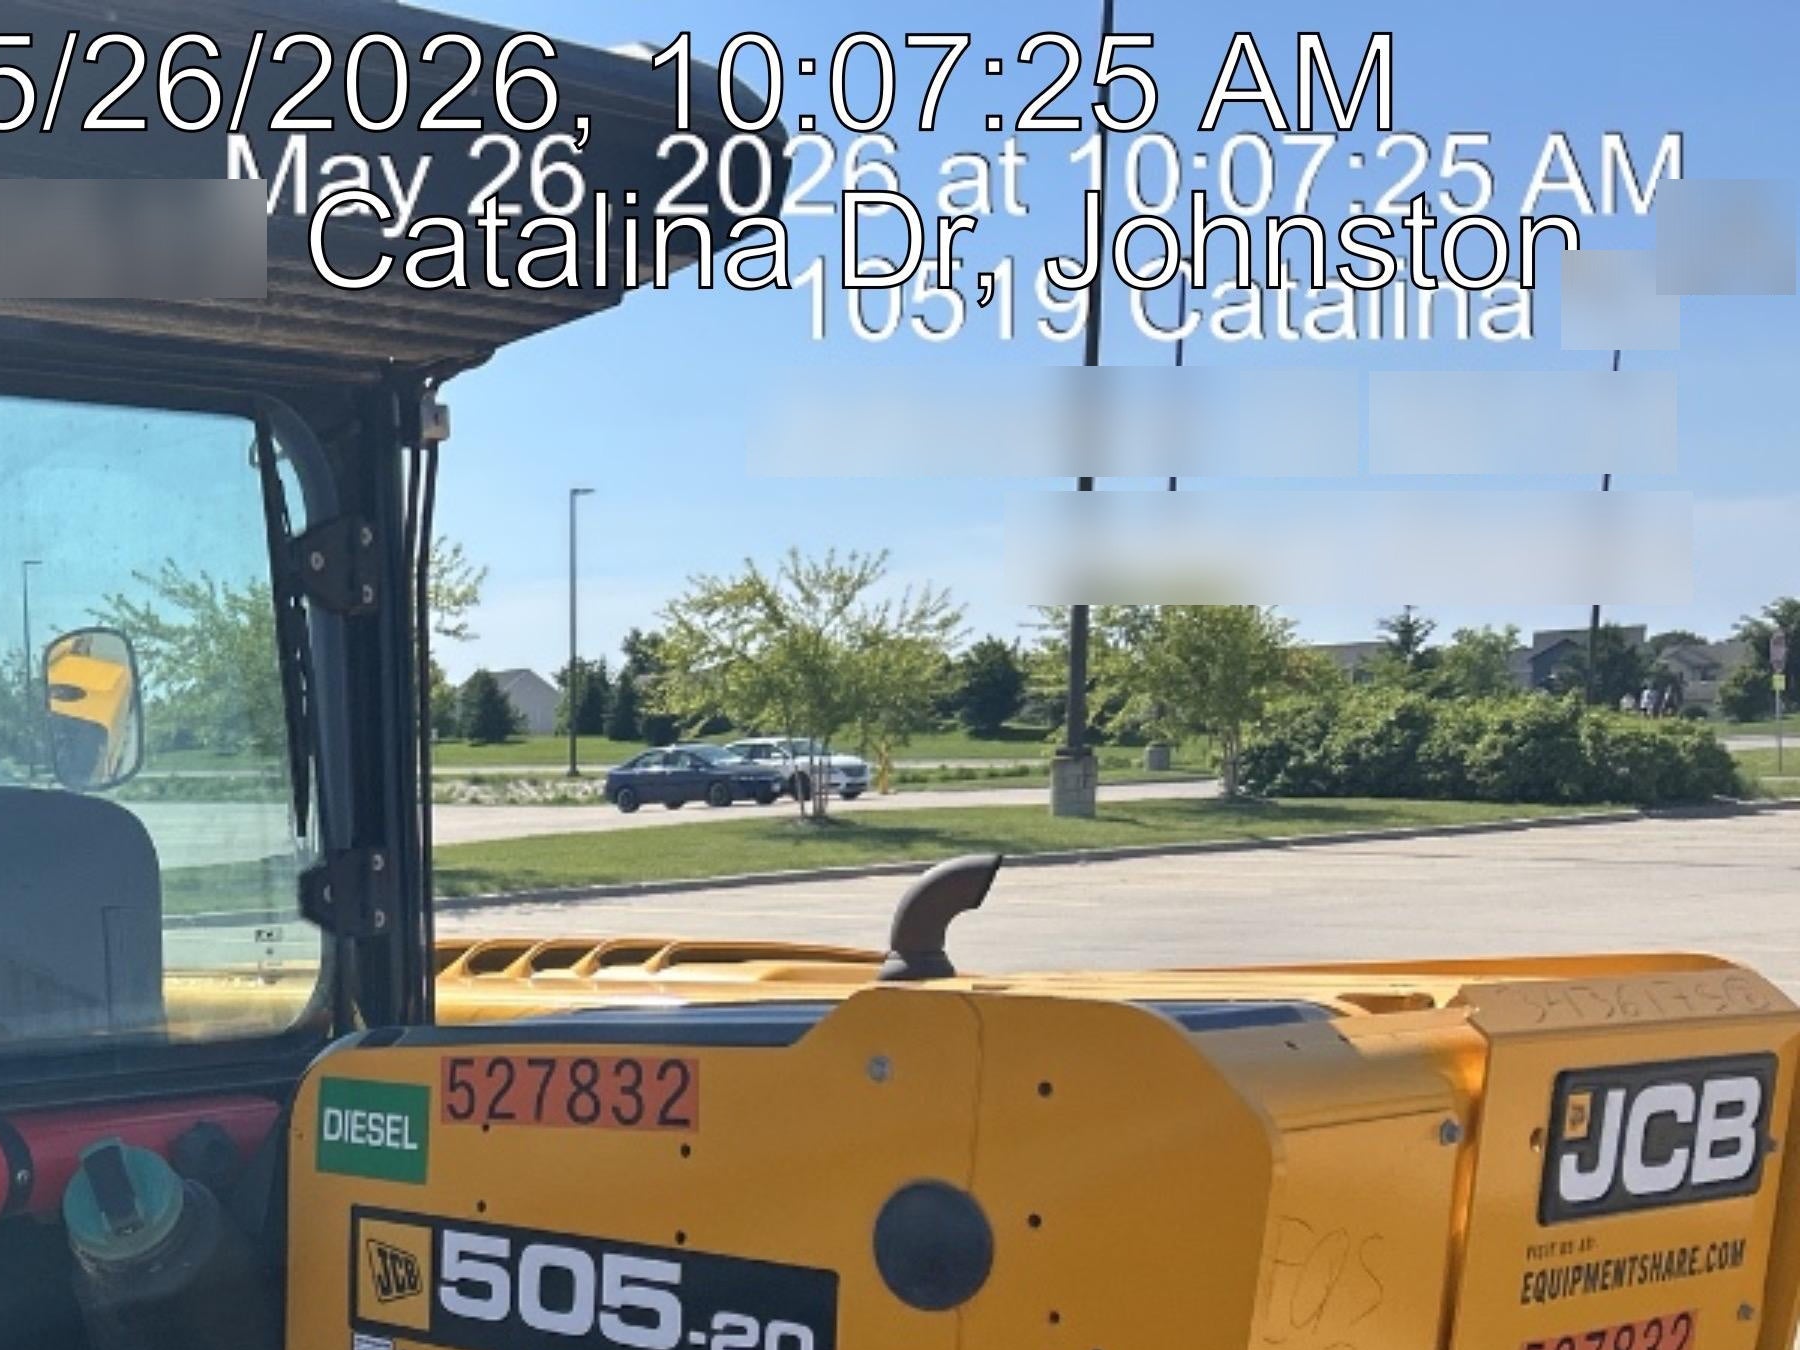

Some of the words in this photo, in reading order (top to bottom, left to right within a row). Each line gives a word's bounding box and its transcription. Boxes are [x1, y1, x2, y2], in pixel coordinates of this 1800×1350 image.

[445, 1056, 692, 1128] 527832
[322, 1106, 419, 1151] DIESEL
[1559, 1075, 1763, 1202] JCB
[375, 1246, 418, 1297] JCB
[1520, 1238, 1748, 1306] EQUIPMENTSHARE.COM
